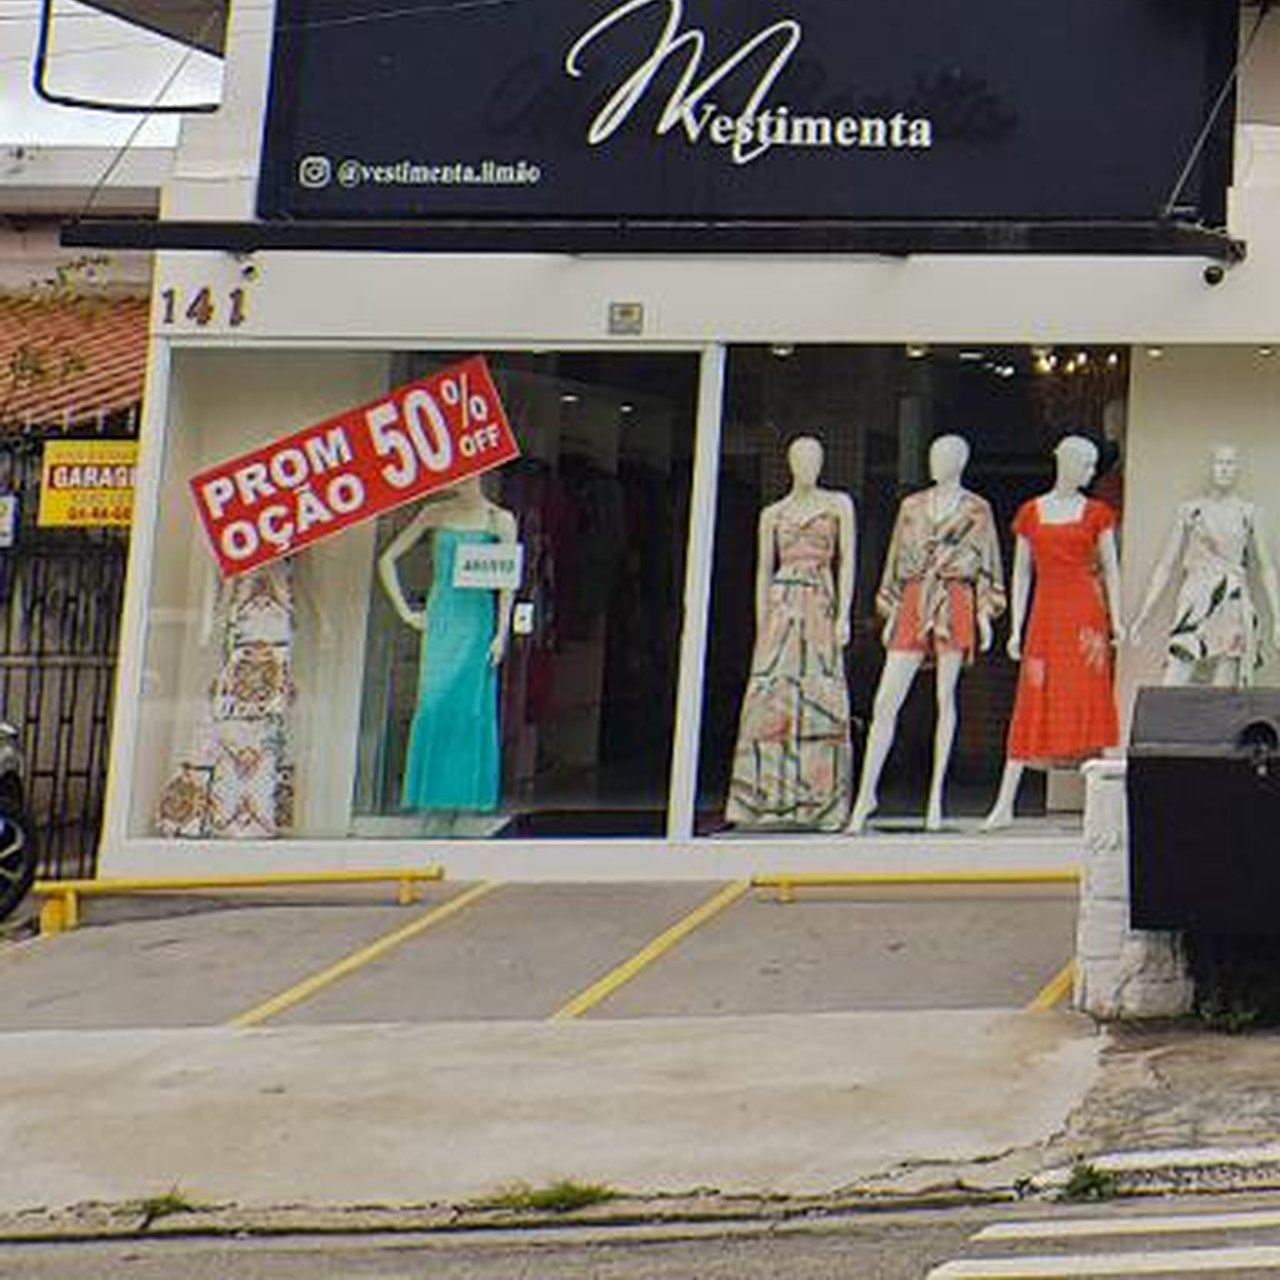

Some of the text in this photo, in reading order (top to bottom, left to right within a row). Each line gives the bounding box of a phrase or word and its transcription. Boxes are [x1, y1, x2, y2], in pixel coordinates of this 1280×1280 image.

[682, 102, 933, 148] Vestimenta
[162, 286, 244, 326] 141
[53, 464, 136, 489] GARAG
[202, 426, 355, 519] PROM
[221, 424, 501, 551] OÇÃO OFF
